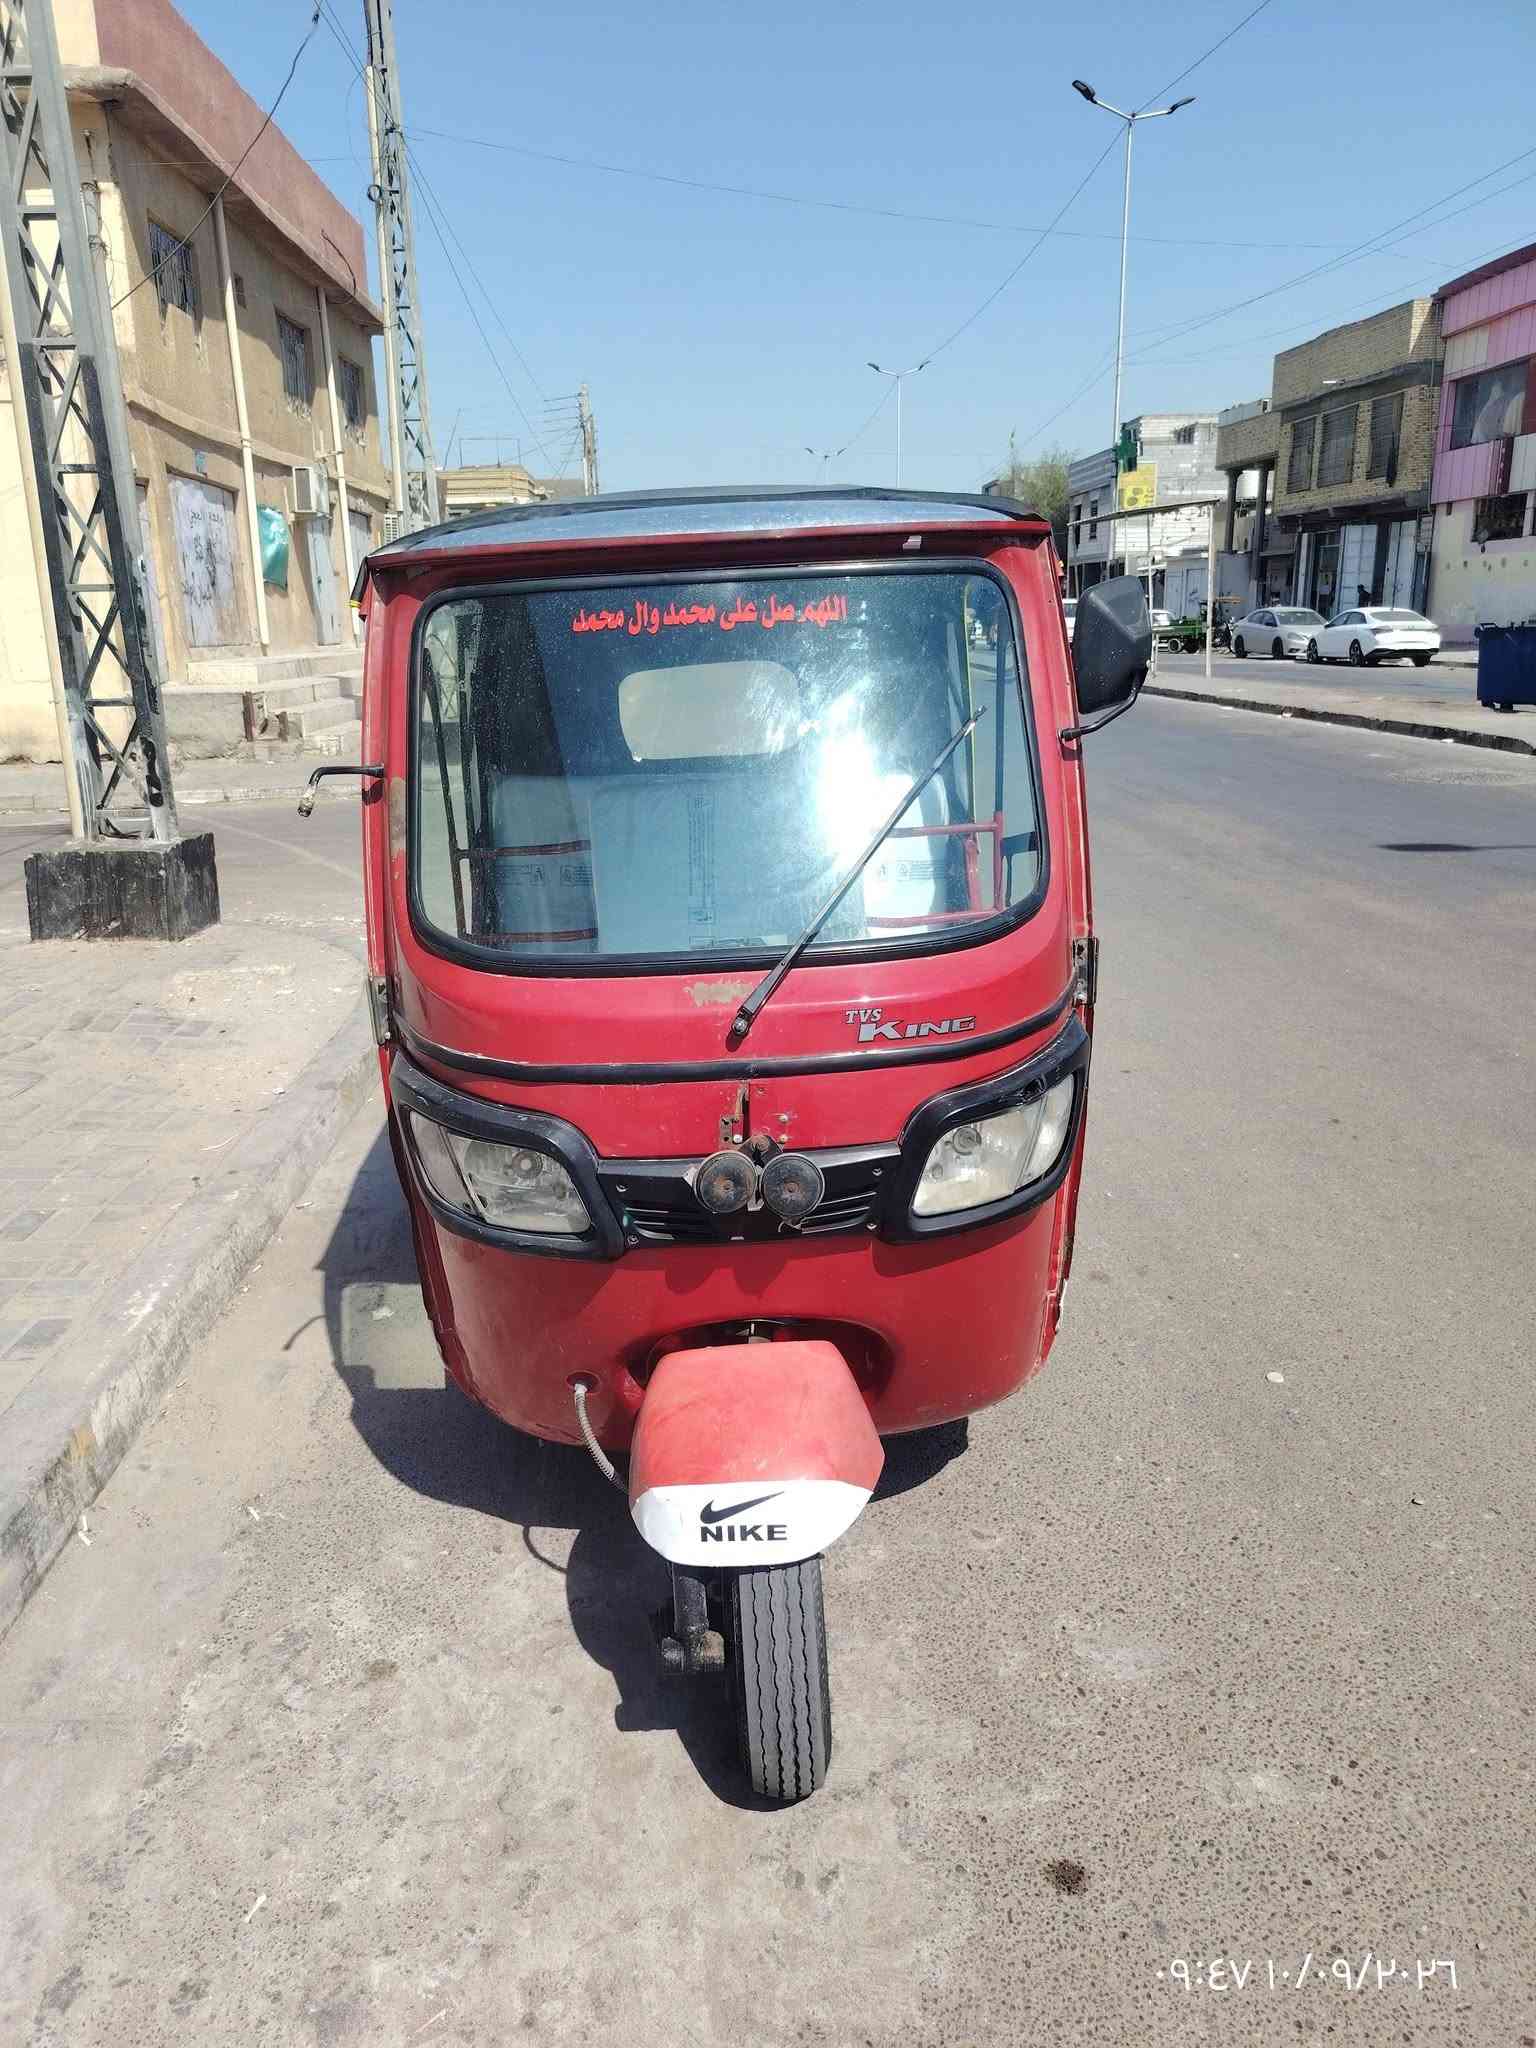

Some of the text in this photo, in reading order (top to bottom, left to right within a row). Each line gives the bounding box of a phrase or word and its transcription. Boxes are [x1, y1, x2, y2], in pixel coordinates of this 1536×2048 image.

[572, 608, 625, 632] محمد
[663, 602, 715, 626] محمد
[720, 596, 757, 630] على
[761, 592, 794, 628] صل
[797, 593, 848, 628] اللهم
[845, 1008, 882, 1024] TVS
[700, 1524, 788, 1543] NIKE
